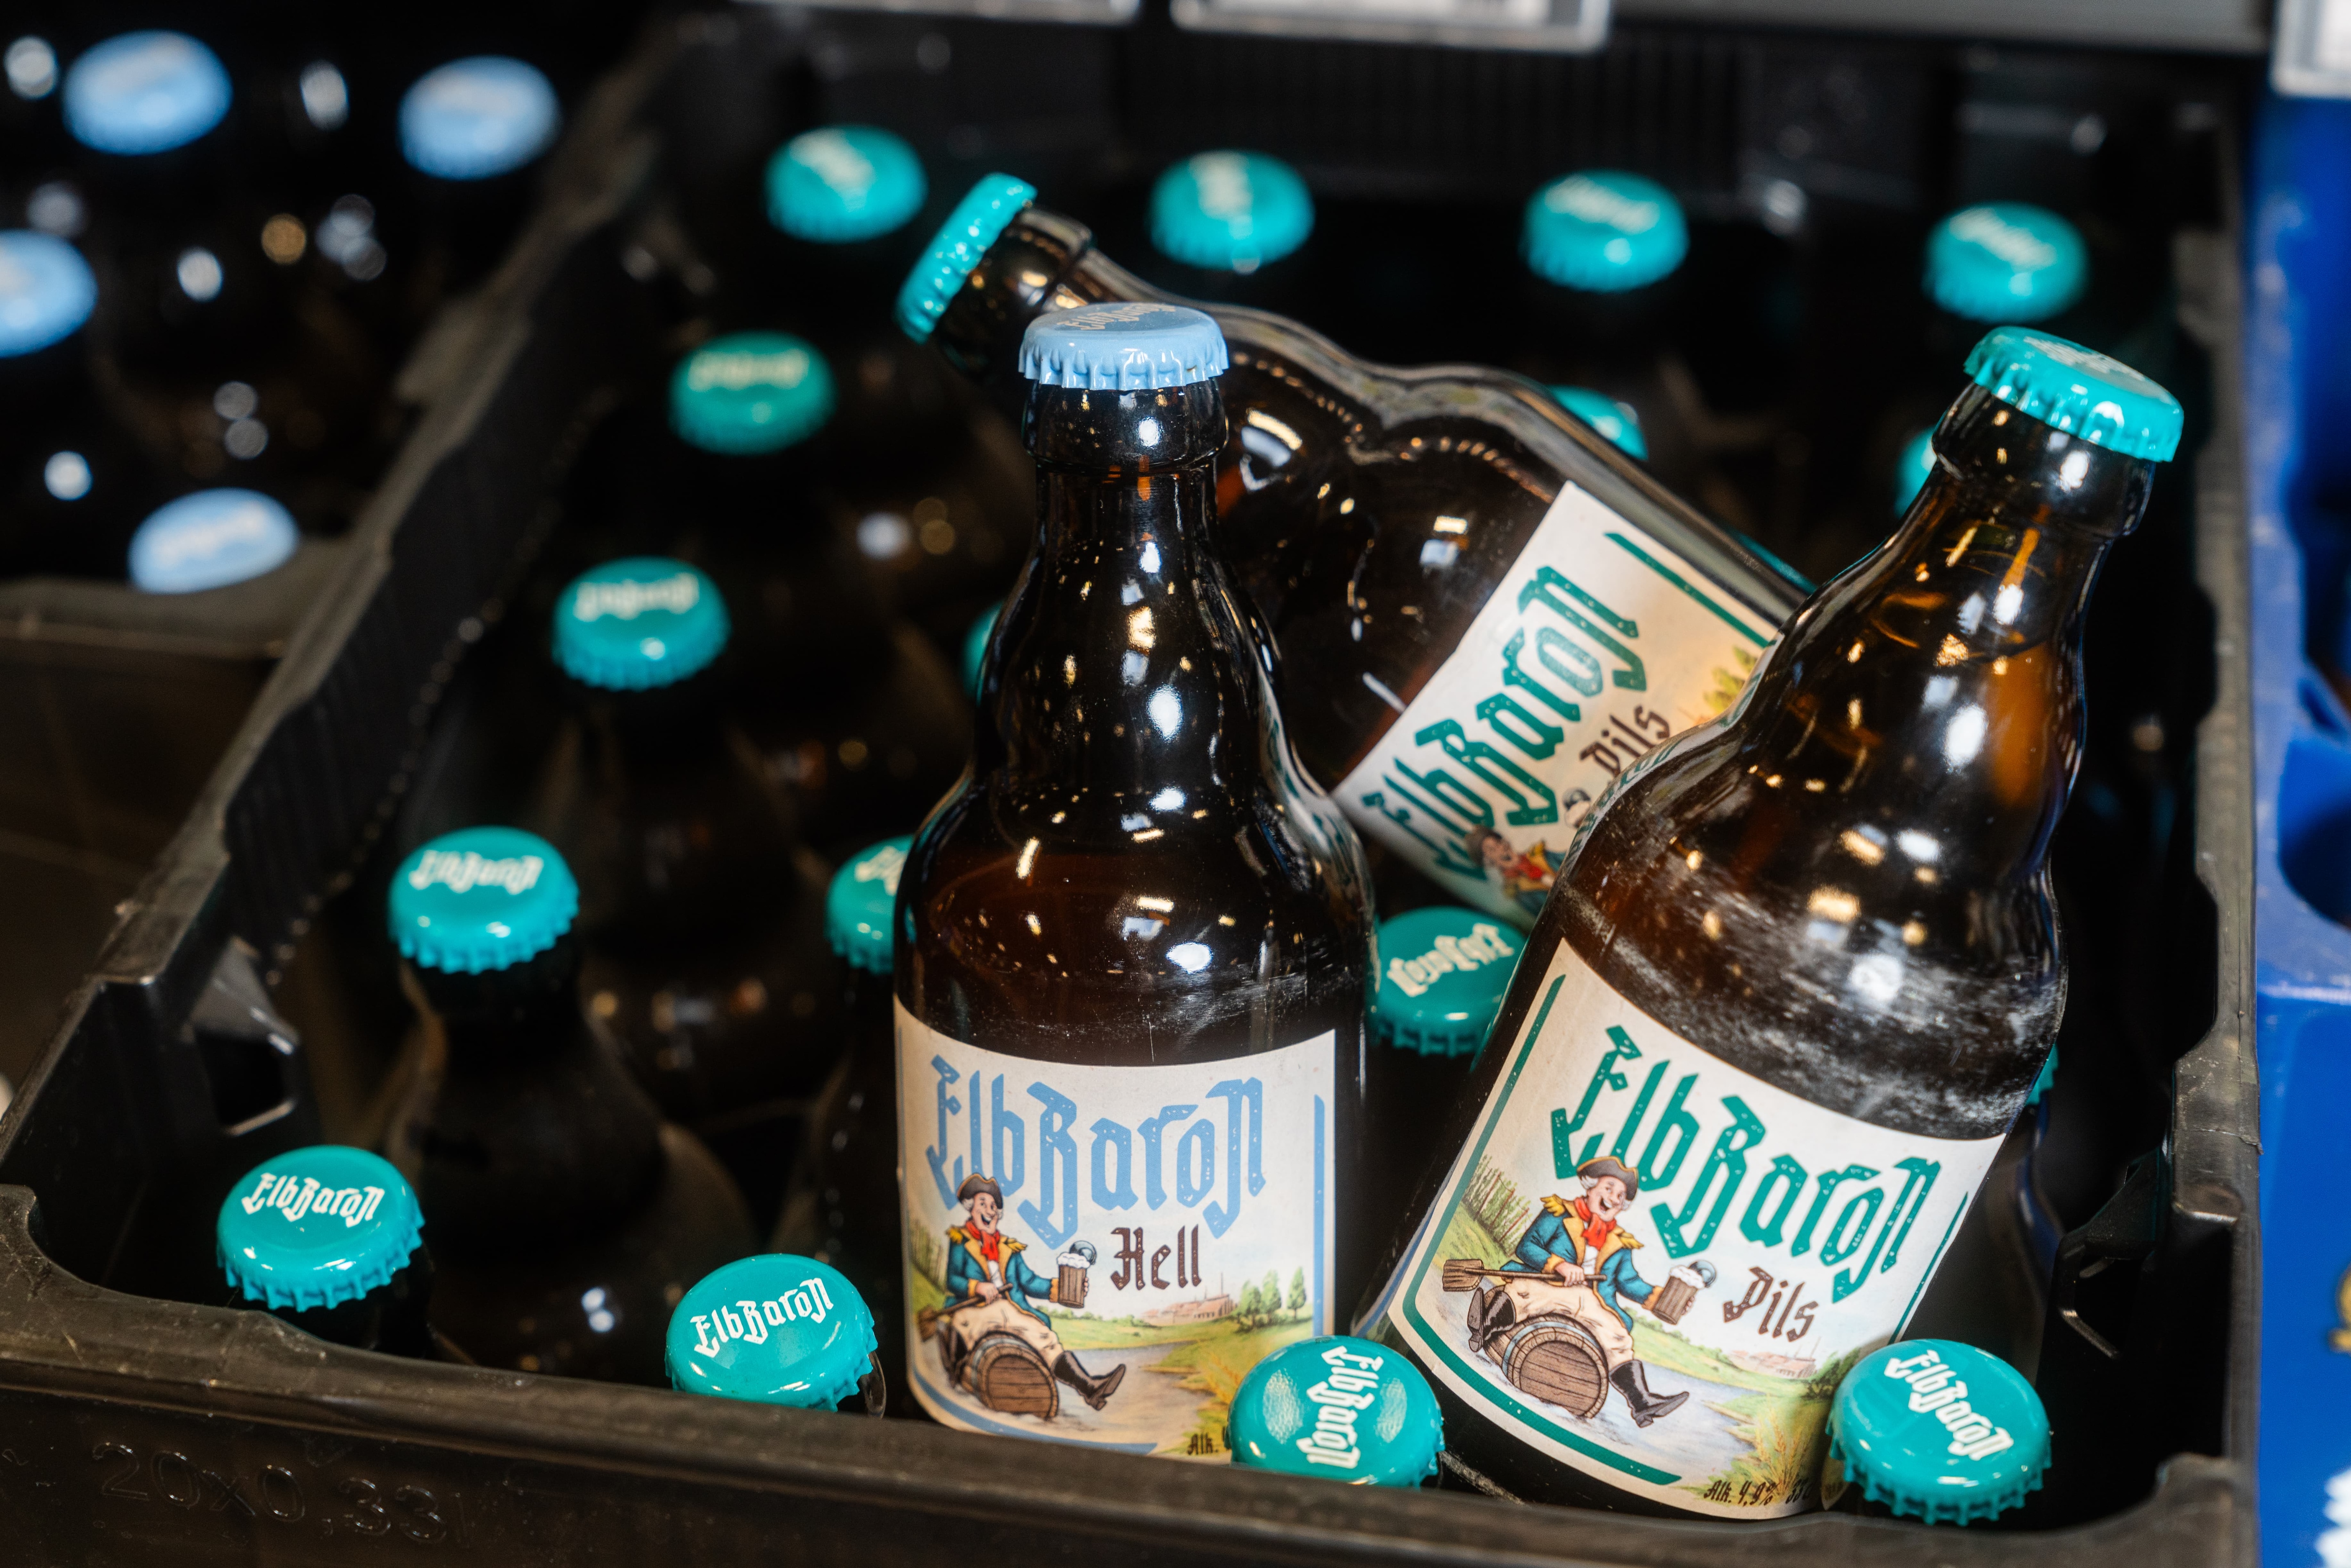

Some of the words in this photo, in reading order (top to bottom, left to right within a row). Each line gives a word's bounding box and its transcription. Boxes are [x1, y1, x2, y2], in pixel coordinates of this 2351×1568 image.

[1110, 1224, 1201, 1290] Hell
[1722, 1266, 1819, 1342] Pils
[1187, 1432, 1218, 1456] Alk.
[1704, 1480, 1731, 1503] Alk.
[1738, 1481, 1779, 1506] 4,9%
